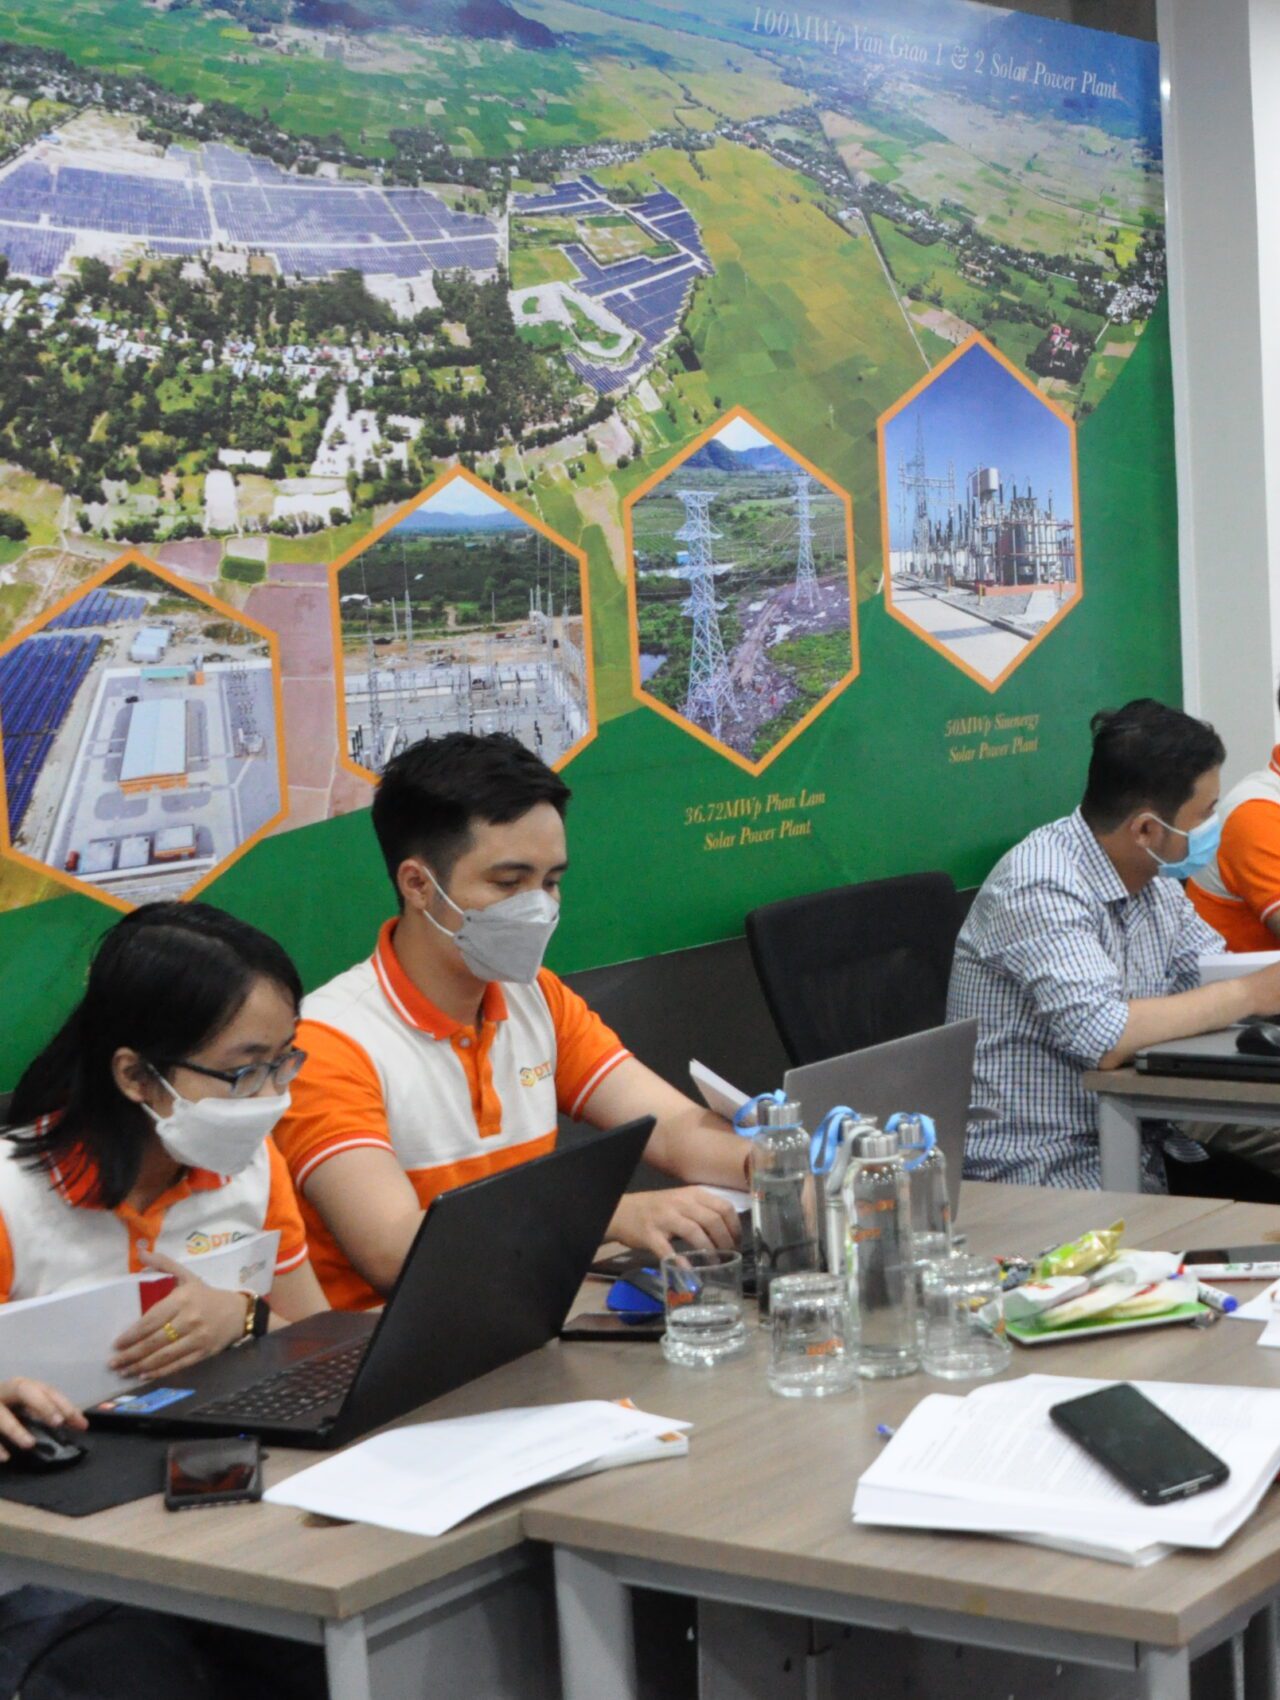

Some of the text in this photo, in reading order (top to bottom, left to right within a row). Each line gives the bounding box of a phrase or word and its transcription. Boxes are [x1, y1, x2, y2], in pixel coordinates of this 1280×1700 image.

[889, 33, 928, 63] Giao
[951, 44, 969, 70] &
[974, 50, 985, 74] 2
[989, 52, 1029, 82] Solar
[1033, 61, 1077, 91] Power
[1081, 70, 1118, 99] Plant
[949, 735, 1039, 763] Solar Power Plant
[684, 788, 826, 826] 36.72MWp Phan Lam
[704, 820, 812, 851] Solar Power Plant
